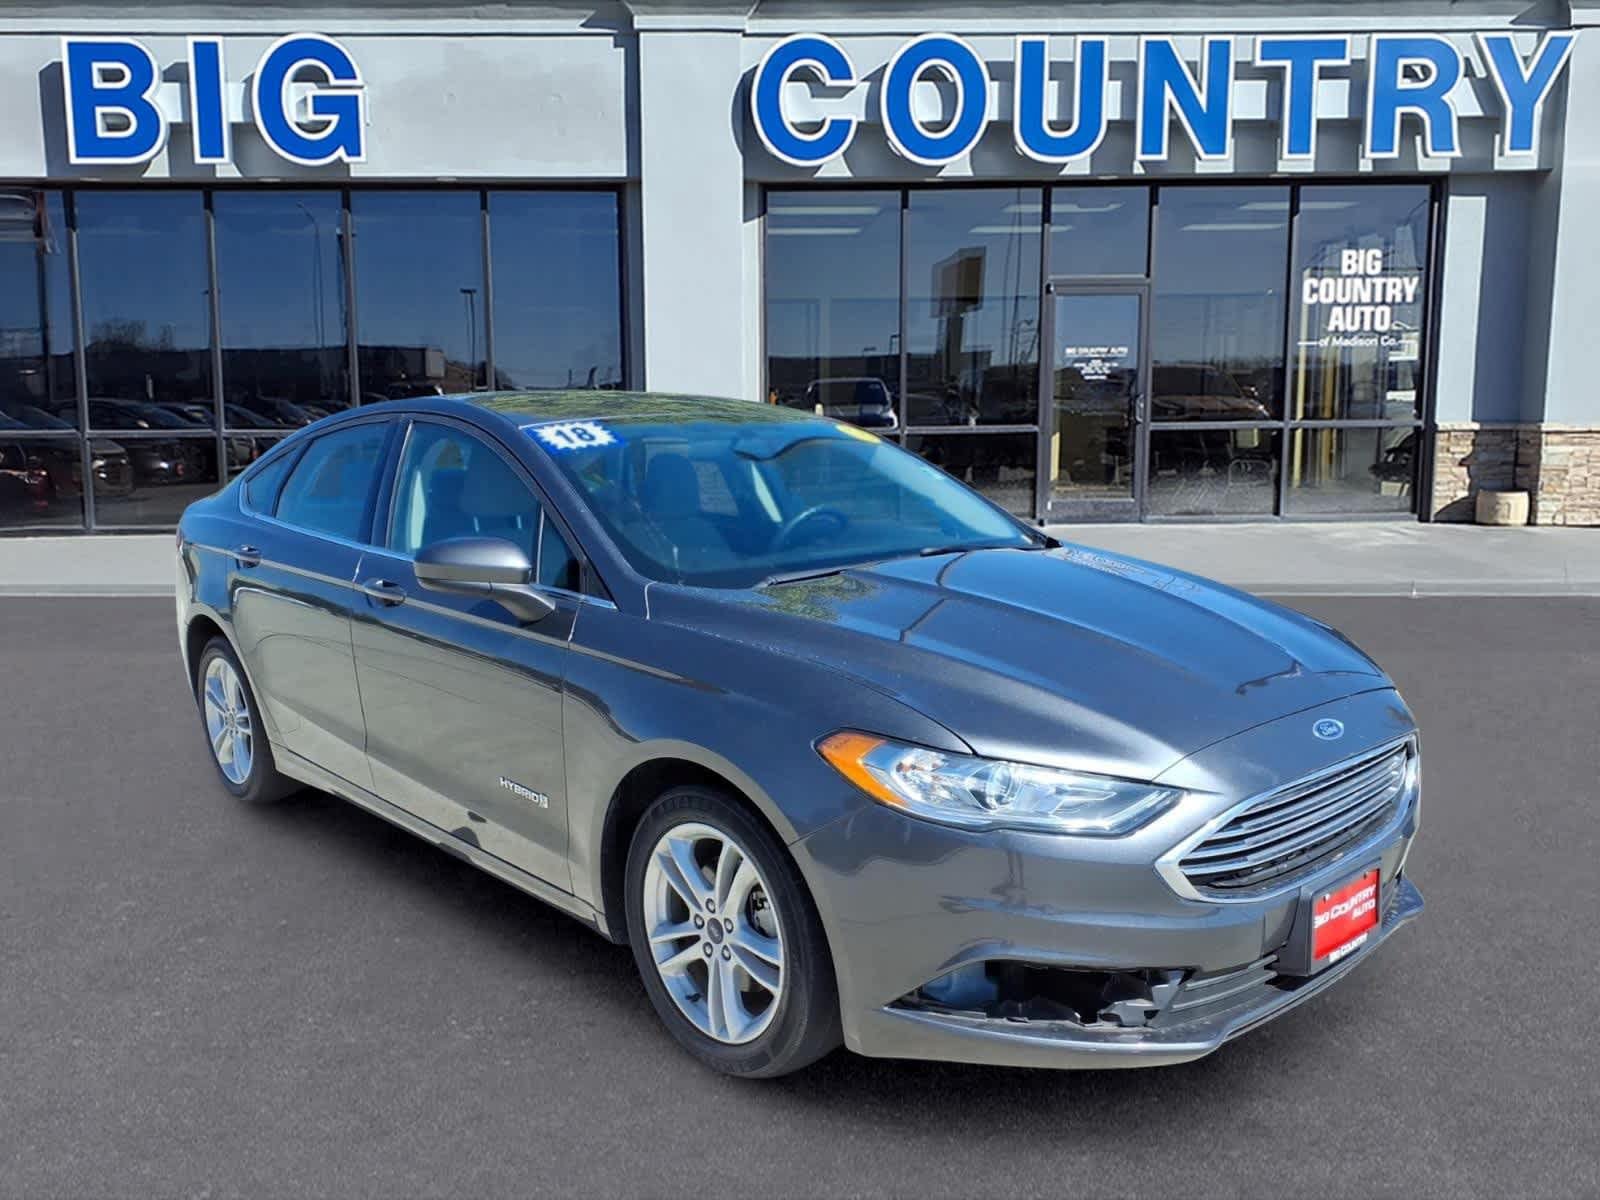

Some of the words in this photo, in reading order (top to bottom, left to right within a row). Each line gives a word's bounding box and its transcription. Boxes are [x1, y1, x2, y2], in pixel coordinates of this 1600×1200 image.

[61, 33, 367, 166] BIG
[750, 31, 1575, 167] COUNTRY
[1341, 249, 1382, 275] BIG
[1303, 276, 1419, 304] COUNTRY
[1328, 305, 1391, 332] AUTO
[1319, 336, 1329, 347] of
[1331, 336, 1378, 347] Madison
[554, 427, 596, 444] 18
[500, 776, 539, 804] HYBRID
[1330, 884, 1377, 919] COUNTRY
[1352, 898, 1376, 920] AUTO
